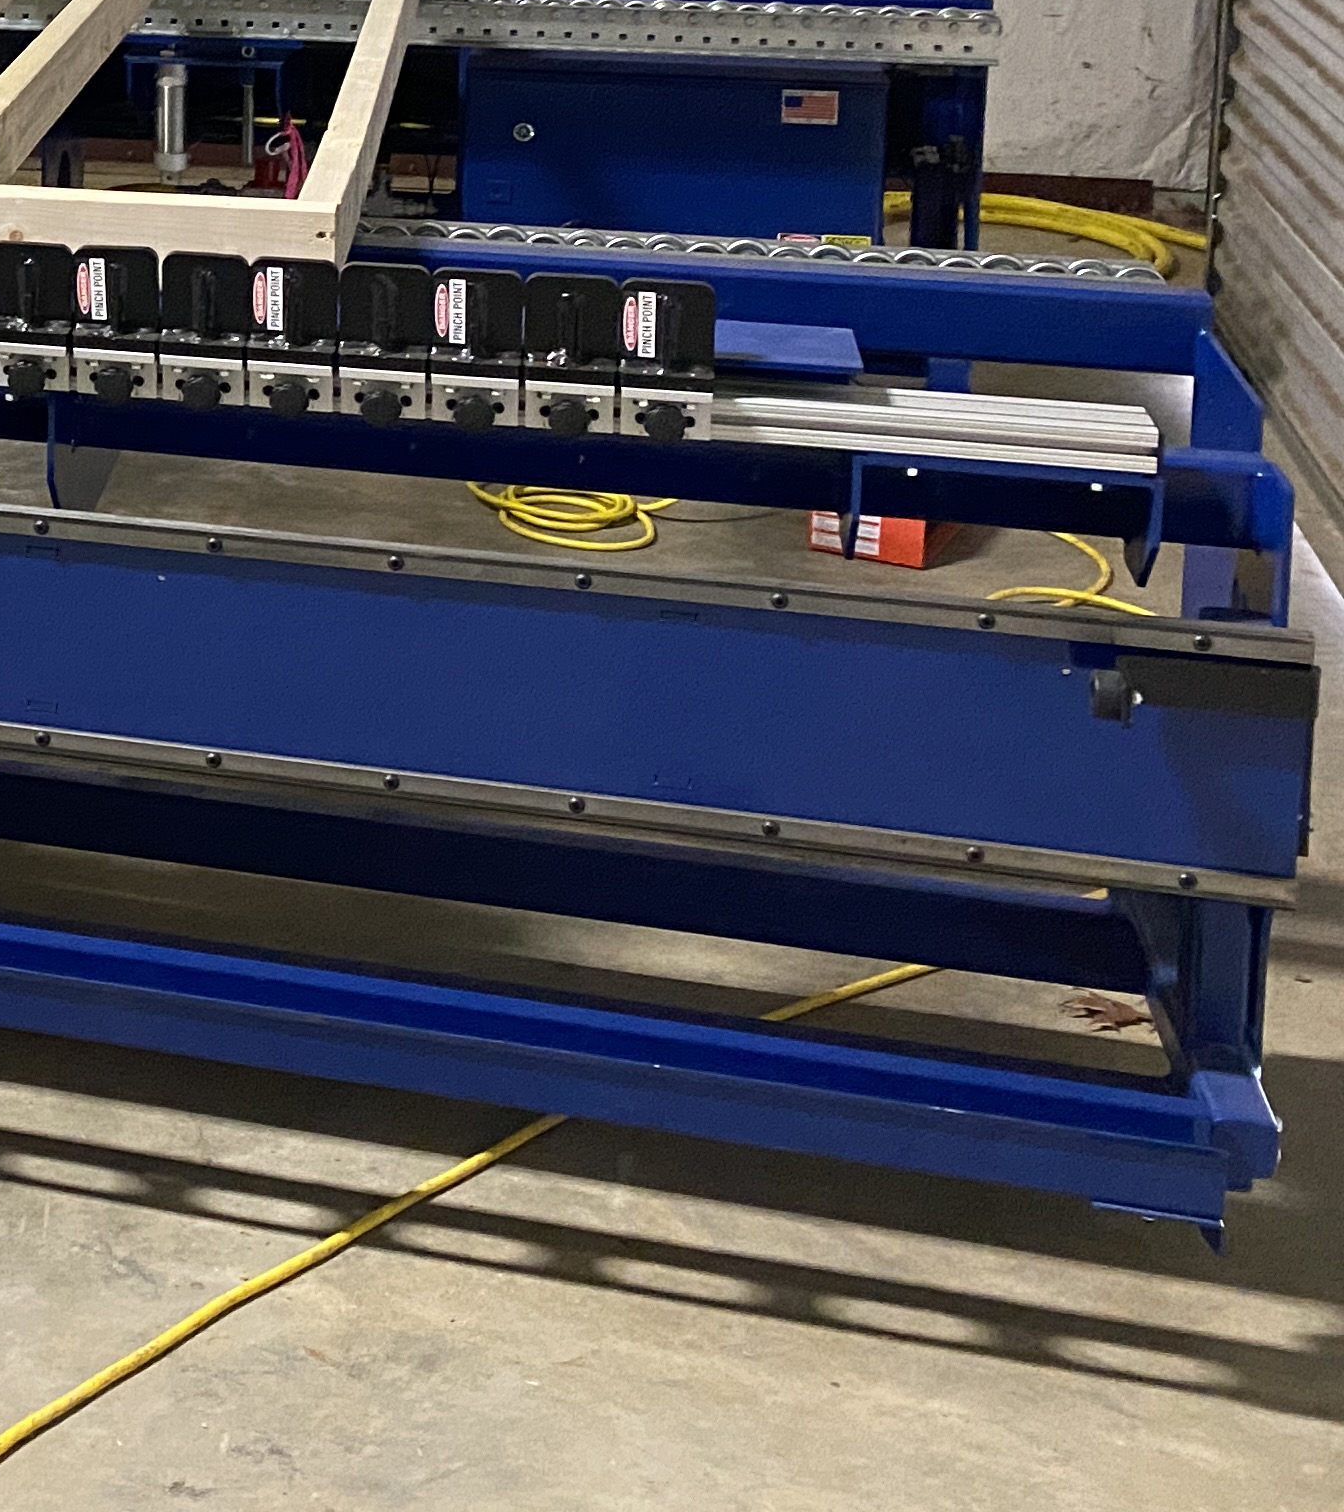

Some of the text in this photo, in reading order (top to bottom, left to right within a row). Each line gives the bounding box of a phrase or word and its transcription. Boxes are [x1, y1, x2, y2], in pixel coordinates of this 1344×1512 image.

[92, 261, 104, 317] PINCH POINT
[270, 270, 281, 328] PINCH POINT
[452, 282, 463, 341] PINCH POINT
[641, 295, 653, 354] PINCH POINT
